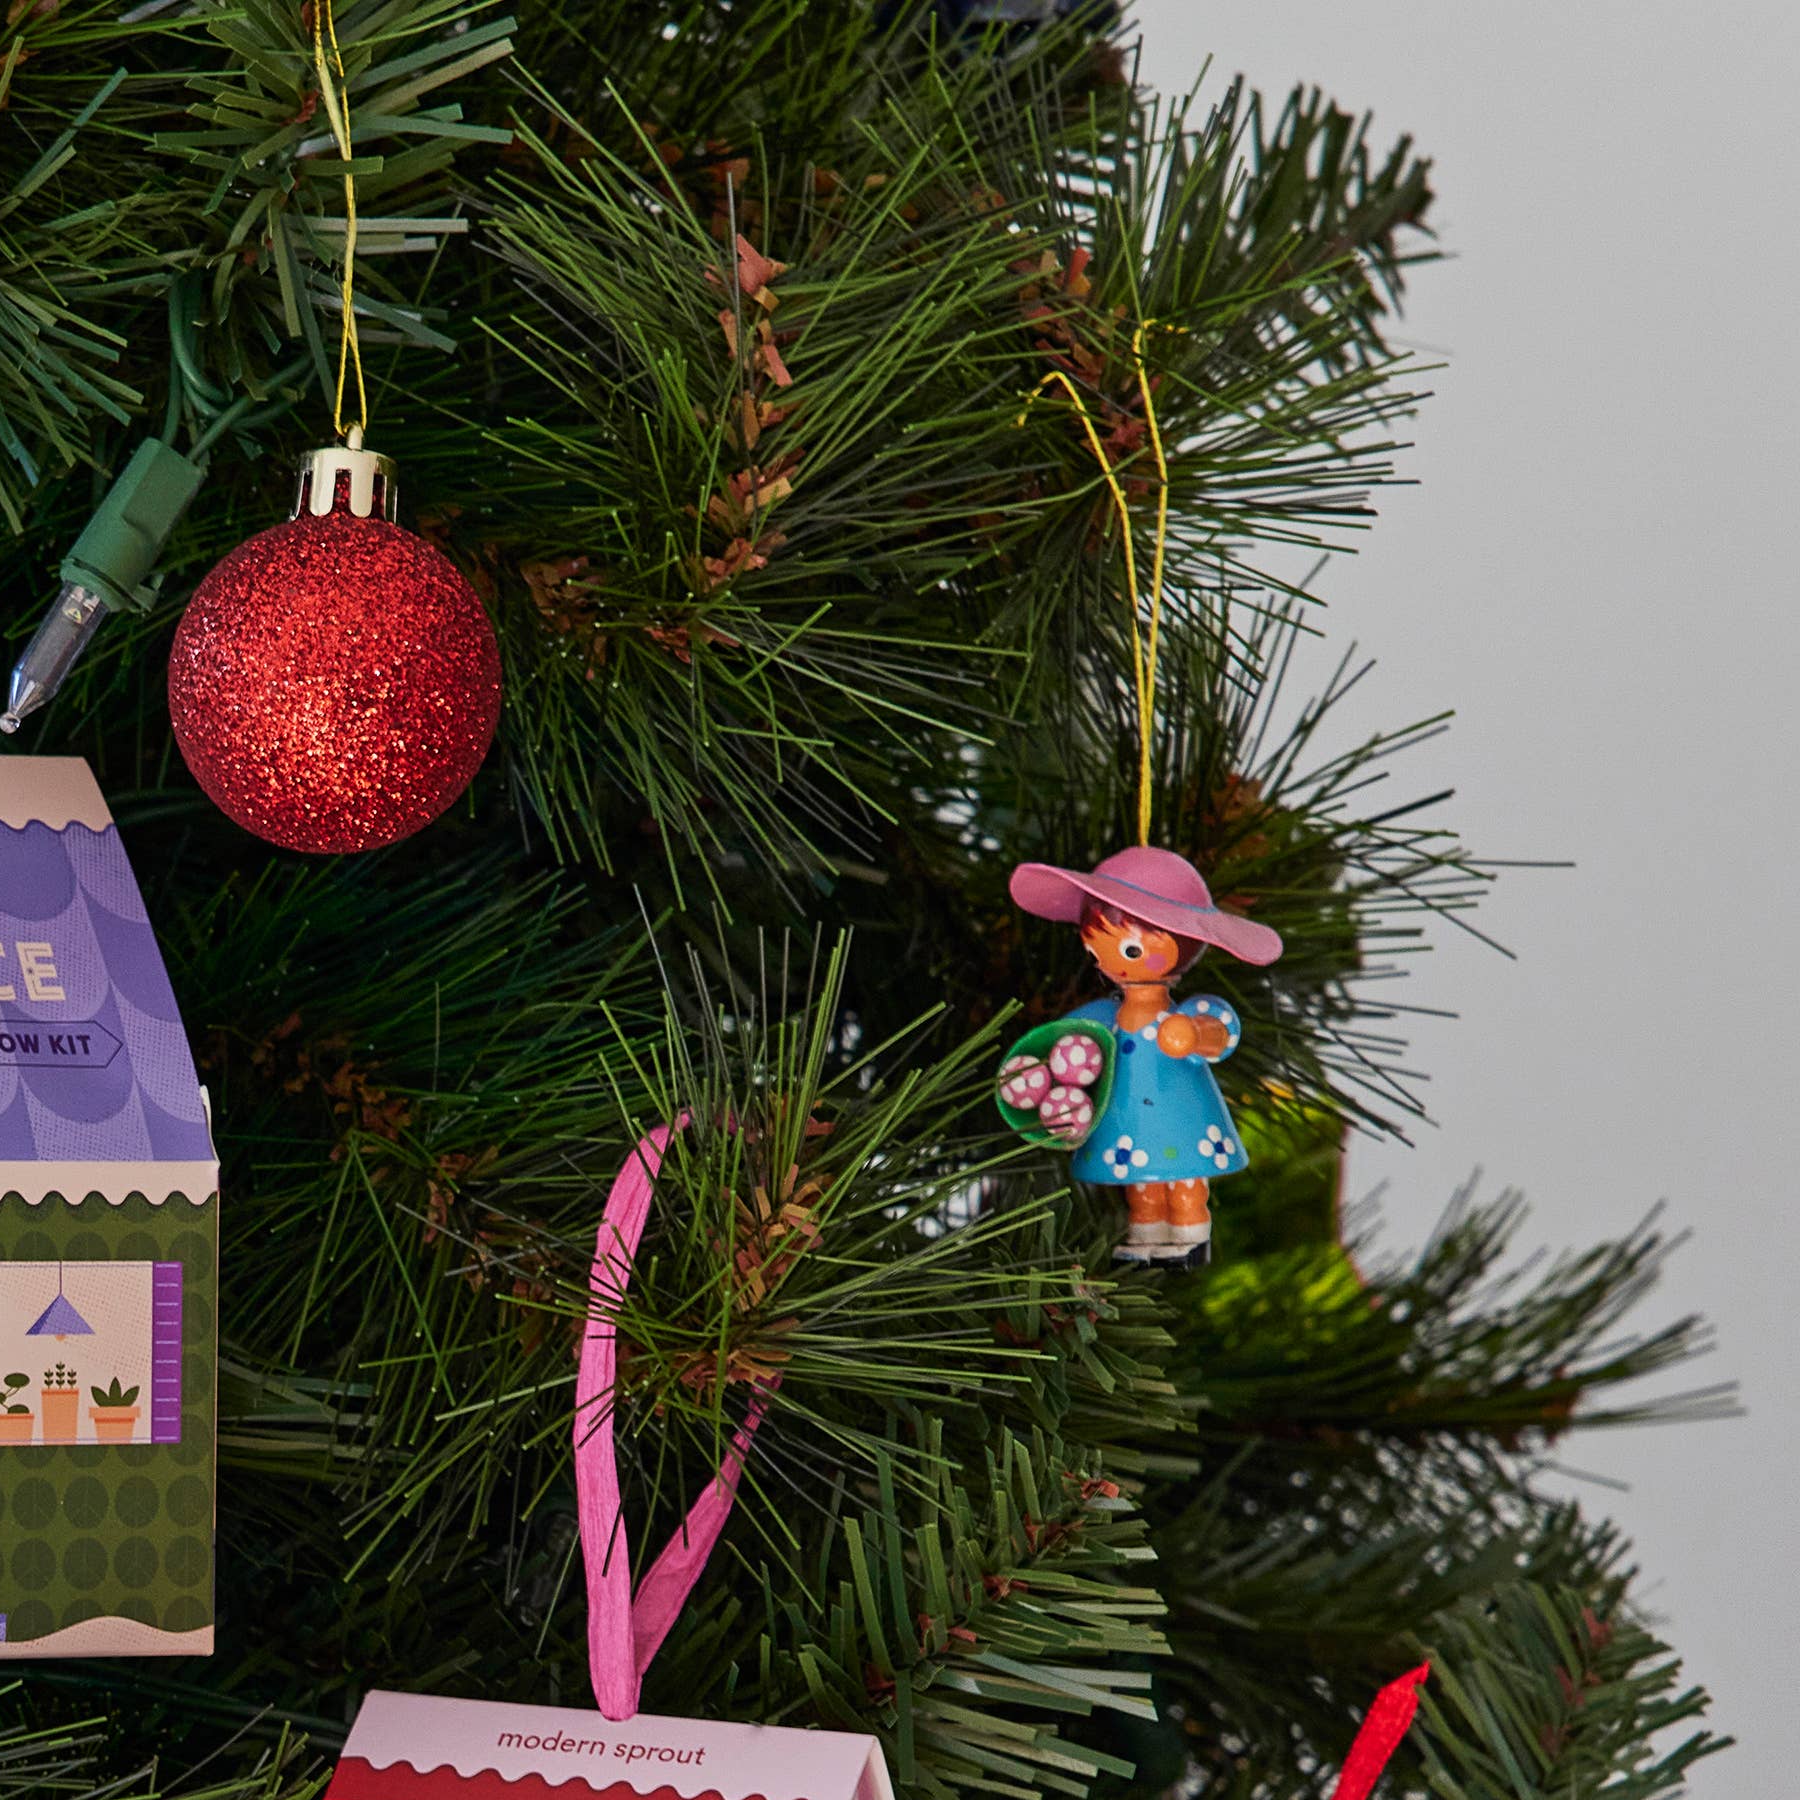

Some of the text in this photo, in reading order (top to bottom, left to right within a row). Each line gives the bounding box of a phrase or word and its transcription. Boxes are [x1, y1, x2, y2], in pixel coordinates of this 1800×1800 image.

[47, 1035, 92, 1055] KIT
[498, 1730, 706, 1766] modern sprout
